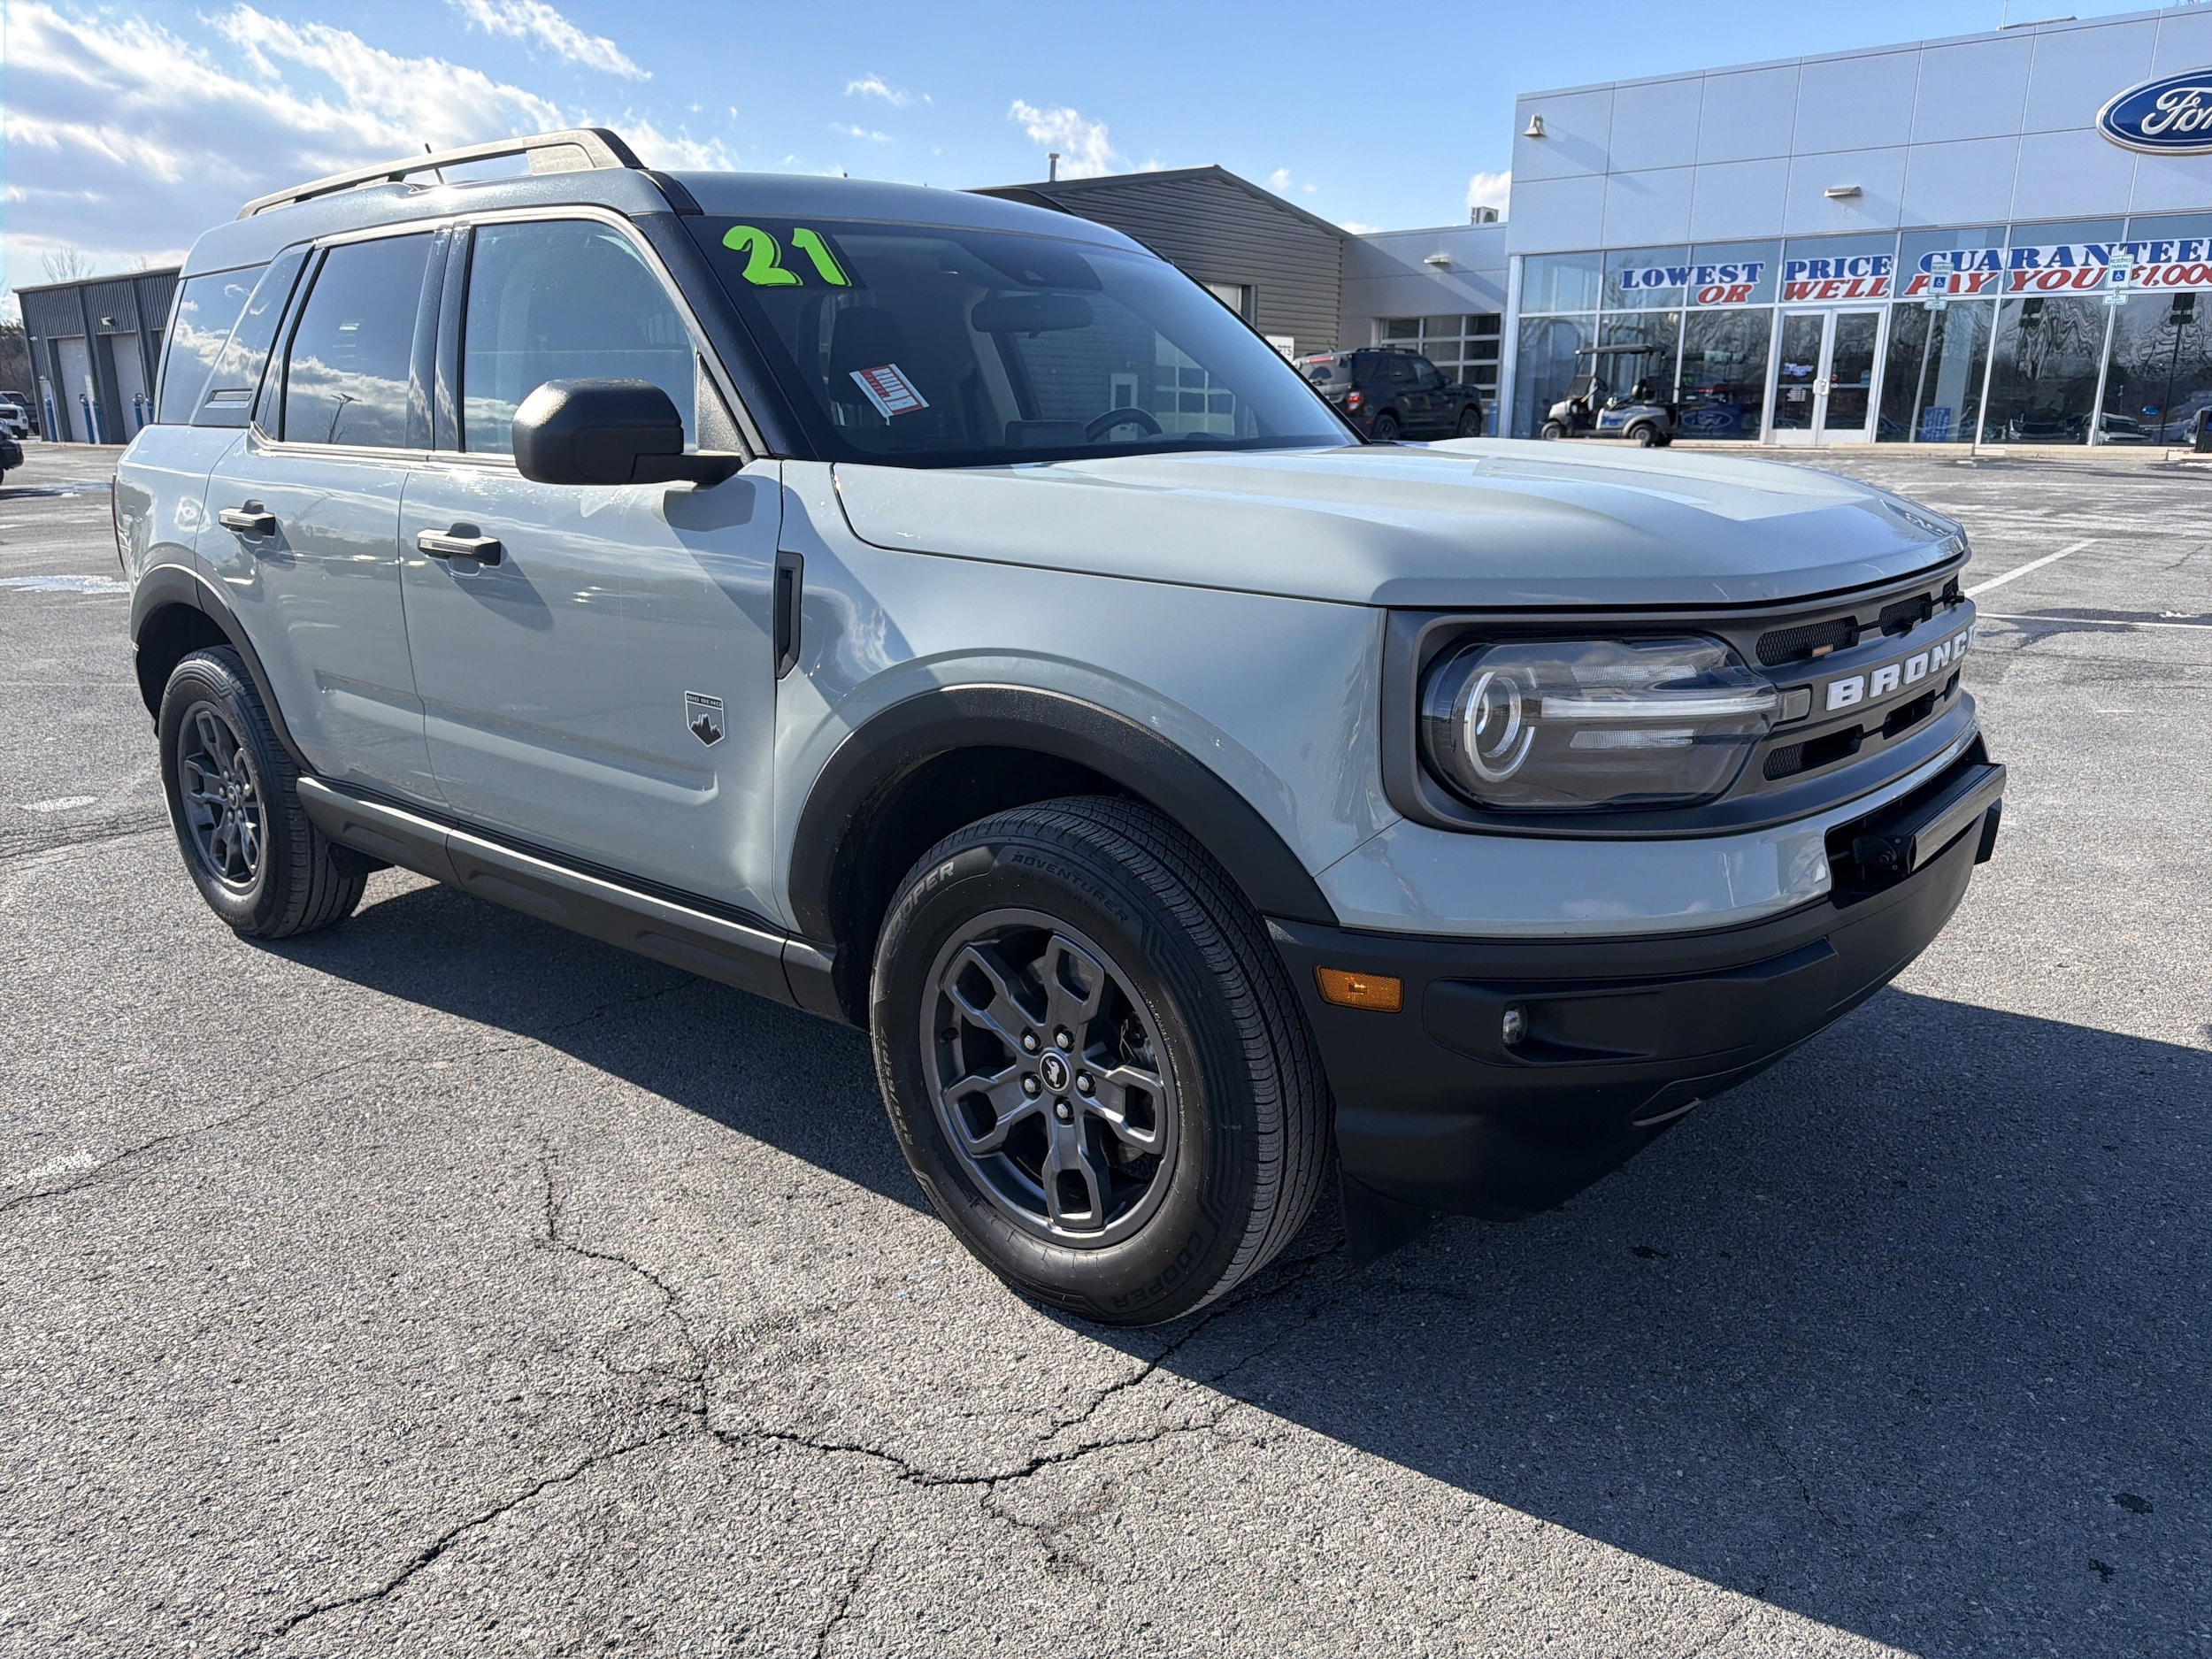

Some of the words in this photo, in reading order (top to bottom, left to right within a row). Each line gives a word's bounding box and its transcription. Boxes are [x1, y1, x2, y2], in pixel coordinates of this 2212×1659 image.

[722, 225, 852, 287] 21
[1621, 263, 1764, 289] LOWEST
[1784, 255, 1893, 280] PRICE
[1919, 239, 2212, 273] GUARANTEE
[1697, 284, 1754, 304] OR
[1784, 278, 1890, 301] WE'LL
[2009, 267, 2108, 292] YOU
[687, 694, 700, 703] BIG
[700, 697, 722, 707] BEND
[1010, 852, 1130, 923] ADVENTURER
[1111, 1230, 1205, 1309] COOPER
